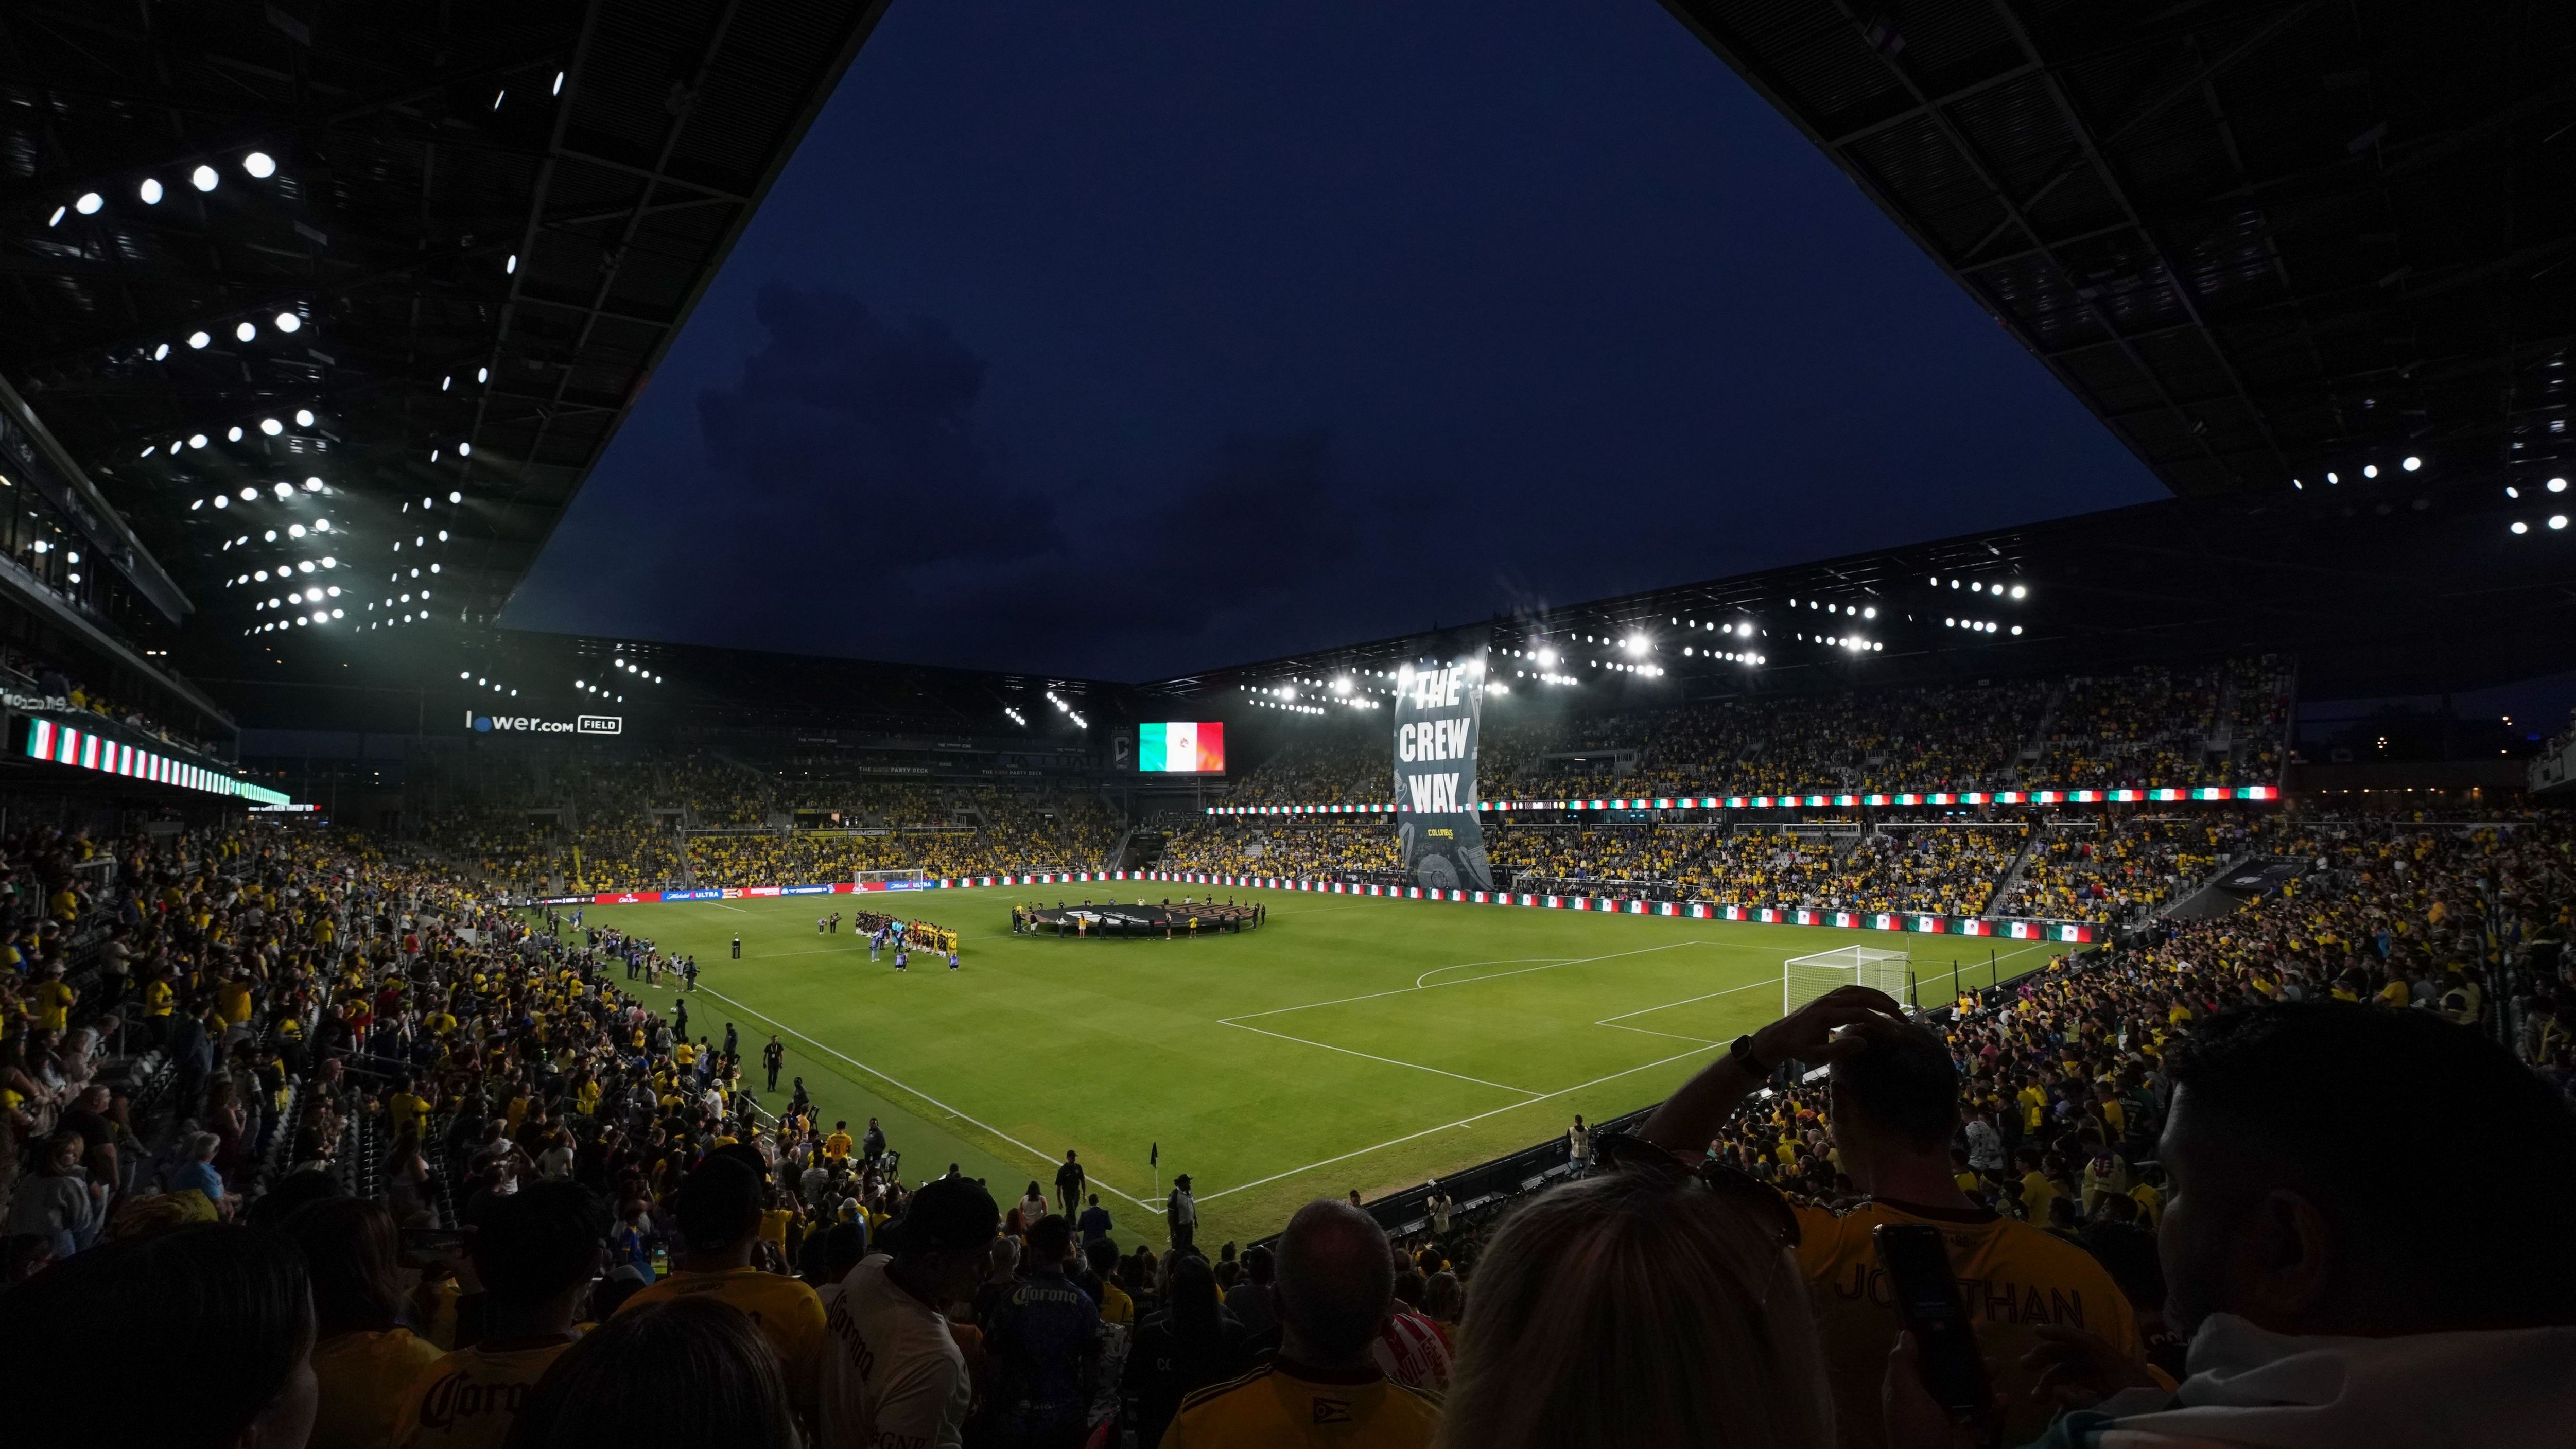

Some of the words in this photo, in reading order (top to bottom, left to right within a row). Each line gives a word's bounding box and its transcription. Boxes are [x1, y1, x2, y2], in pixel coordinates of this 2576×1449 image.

[1416, 667, 1464, 709] THE
[584, 720, 616, 729] FIELD
[1399, 718, 1471, 762] CREW
[1408, 772, 1463, 814] WAY.
[1012, 1285, 1077, 1306] Corona
[1834, 1264, 2084, 1330] JOTHAN
[828, 1288, 874, 1386] Corona
[420, 1369, 544, 1434] Coro
